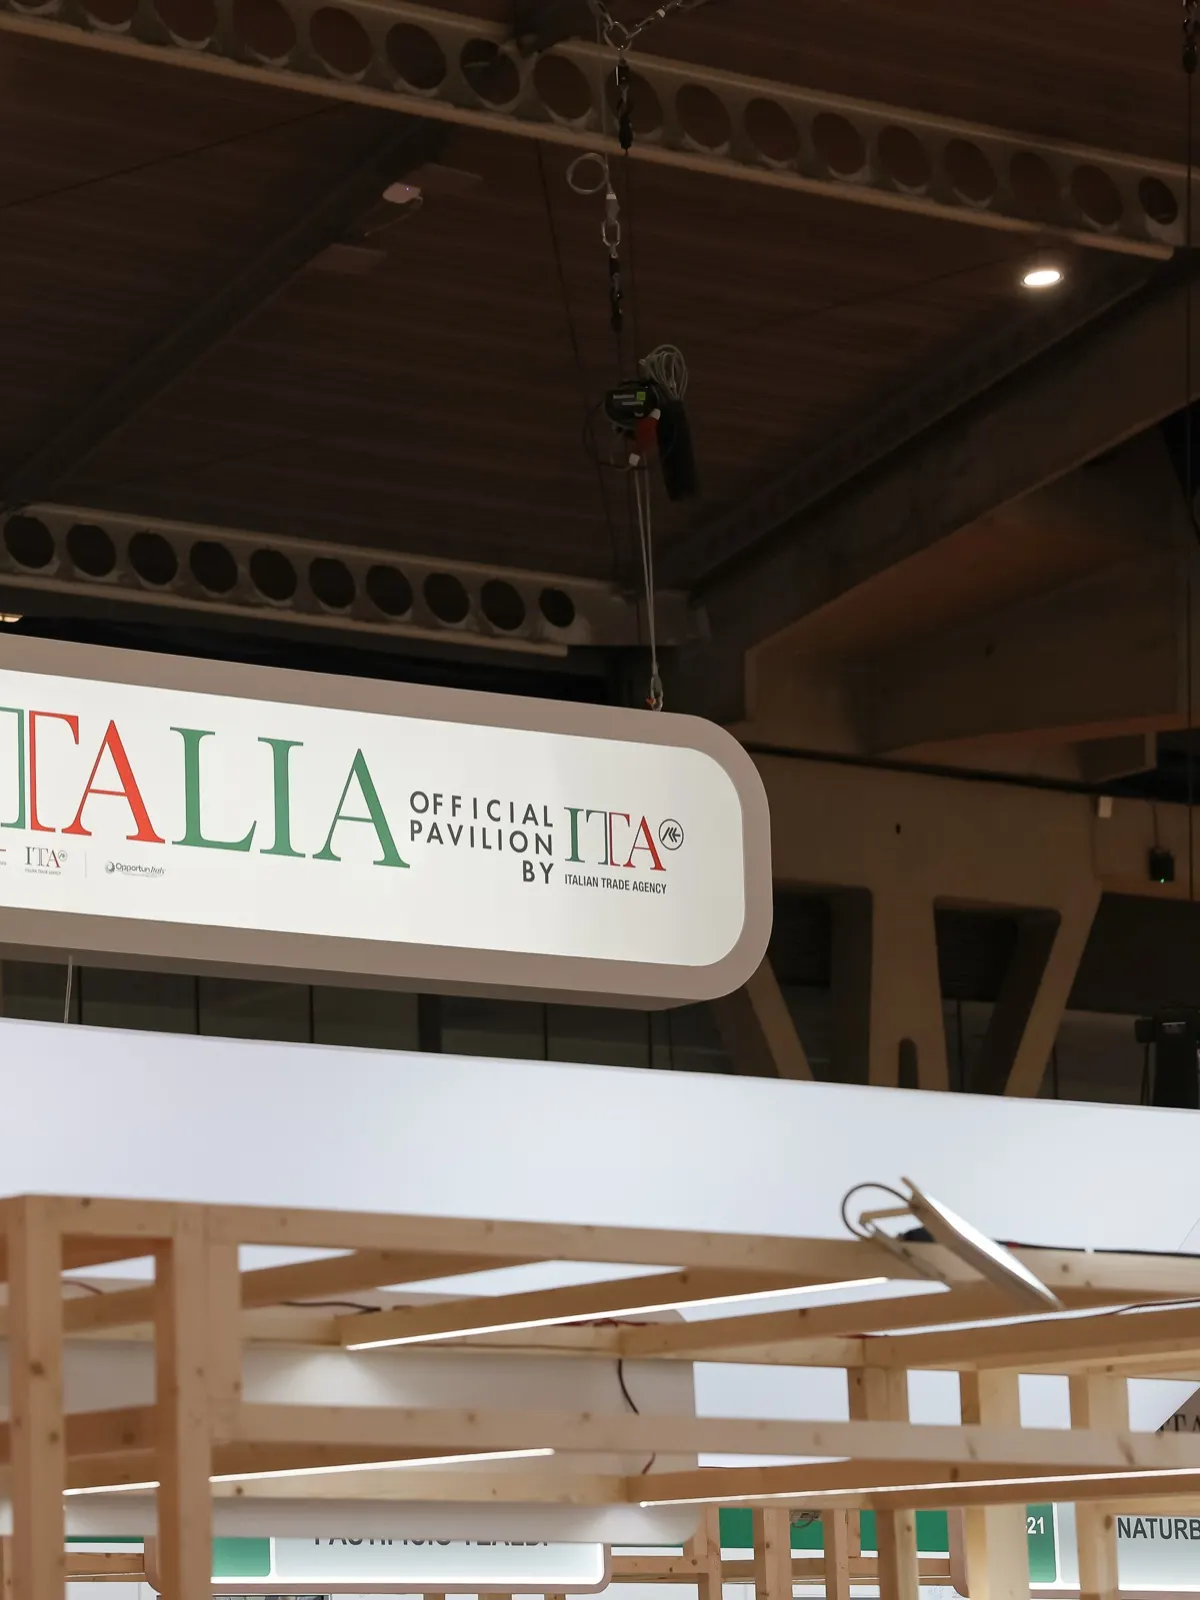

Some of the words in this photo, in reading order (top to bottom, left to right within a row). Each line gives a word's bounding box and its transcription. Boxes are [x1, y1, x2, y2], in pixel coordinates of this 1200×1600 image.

[410, 791, 553, 827] OFFICIAL
[410, 820, 552, 856] PAVILION
[564, 807, 666, 871] ITA
[25, 846, 61, 868] ITA
[522, 860, 554, 884] BY
[565, 874, 599, 888] ITALIAN
[601, 877, 630, 891] TRADE
[632, 881, 667, 894] AGENCY
